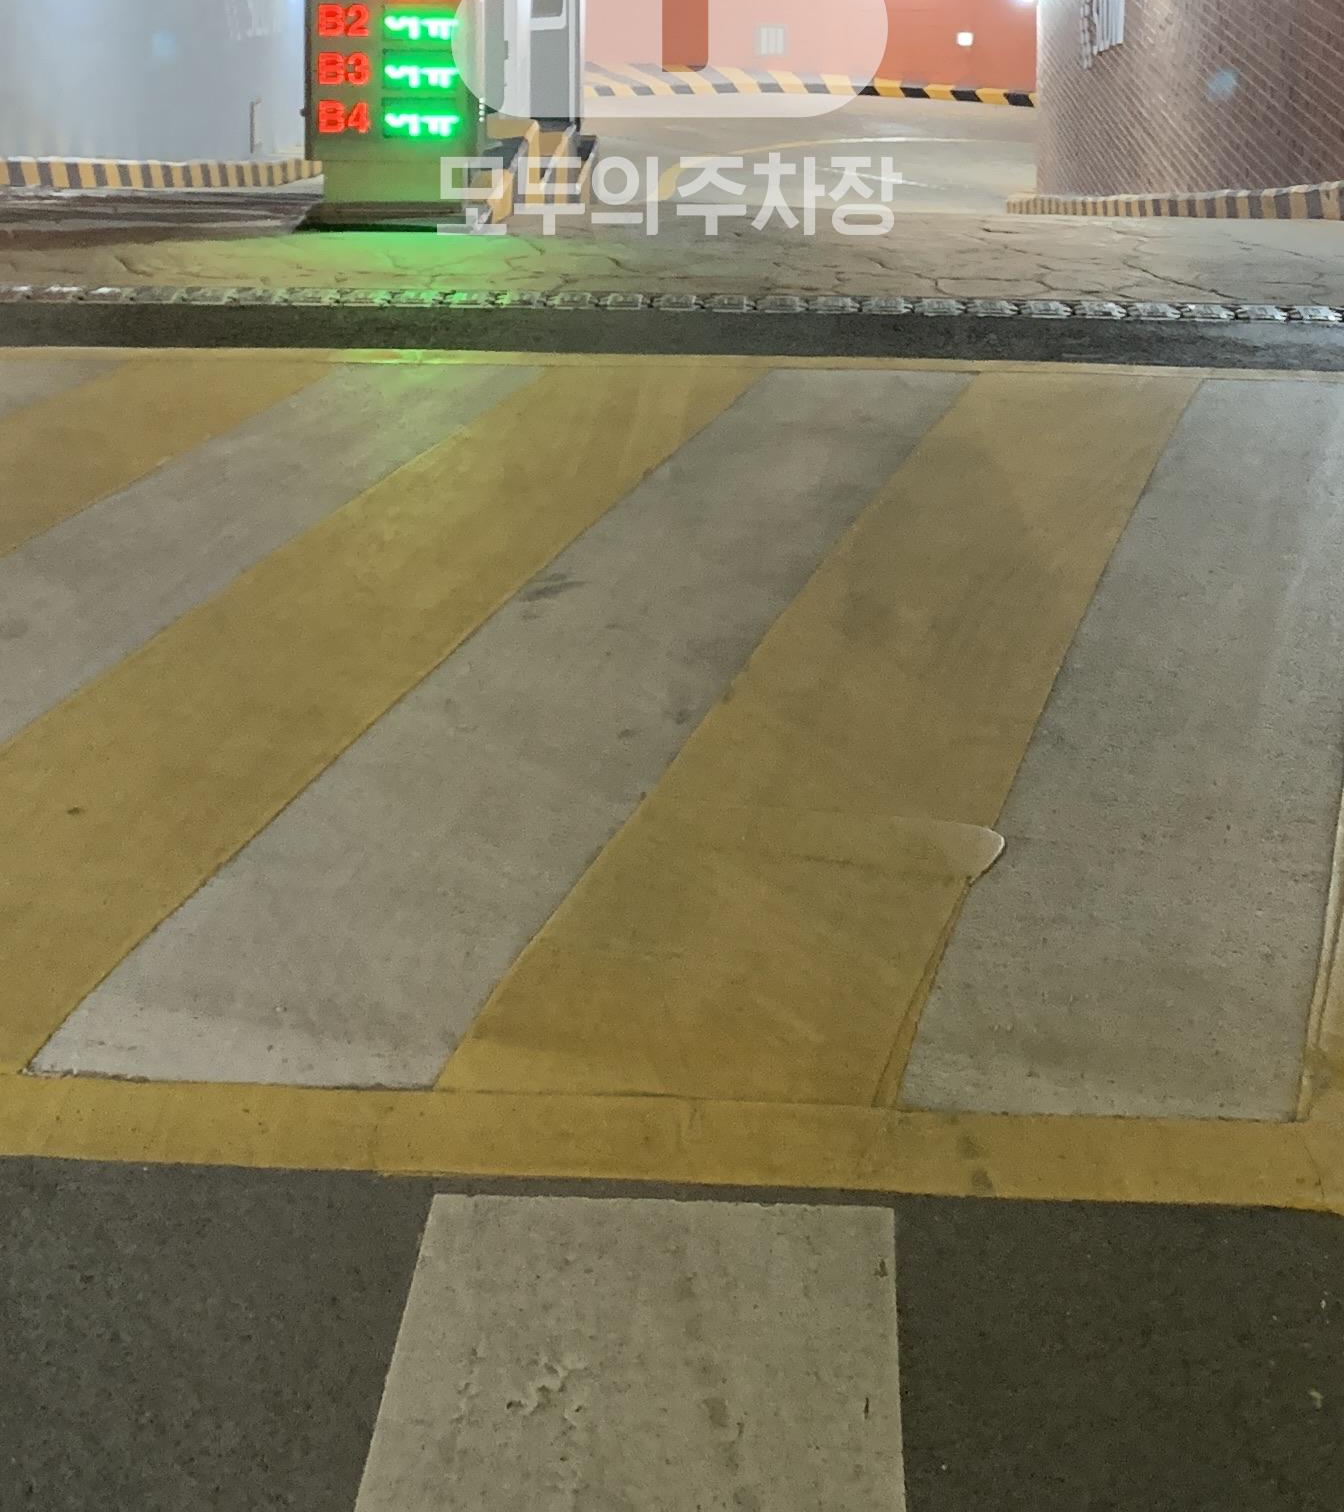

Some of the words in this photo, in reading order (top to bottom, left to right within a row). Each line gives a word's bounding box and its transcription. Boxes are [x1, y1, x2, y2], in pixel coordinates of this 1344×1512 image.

[317, 3, 370, 37] B2
[317, 52, 371, 85] B3
[317, 100, 371, 134] B4
